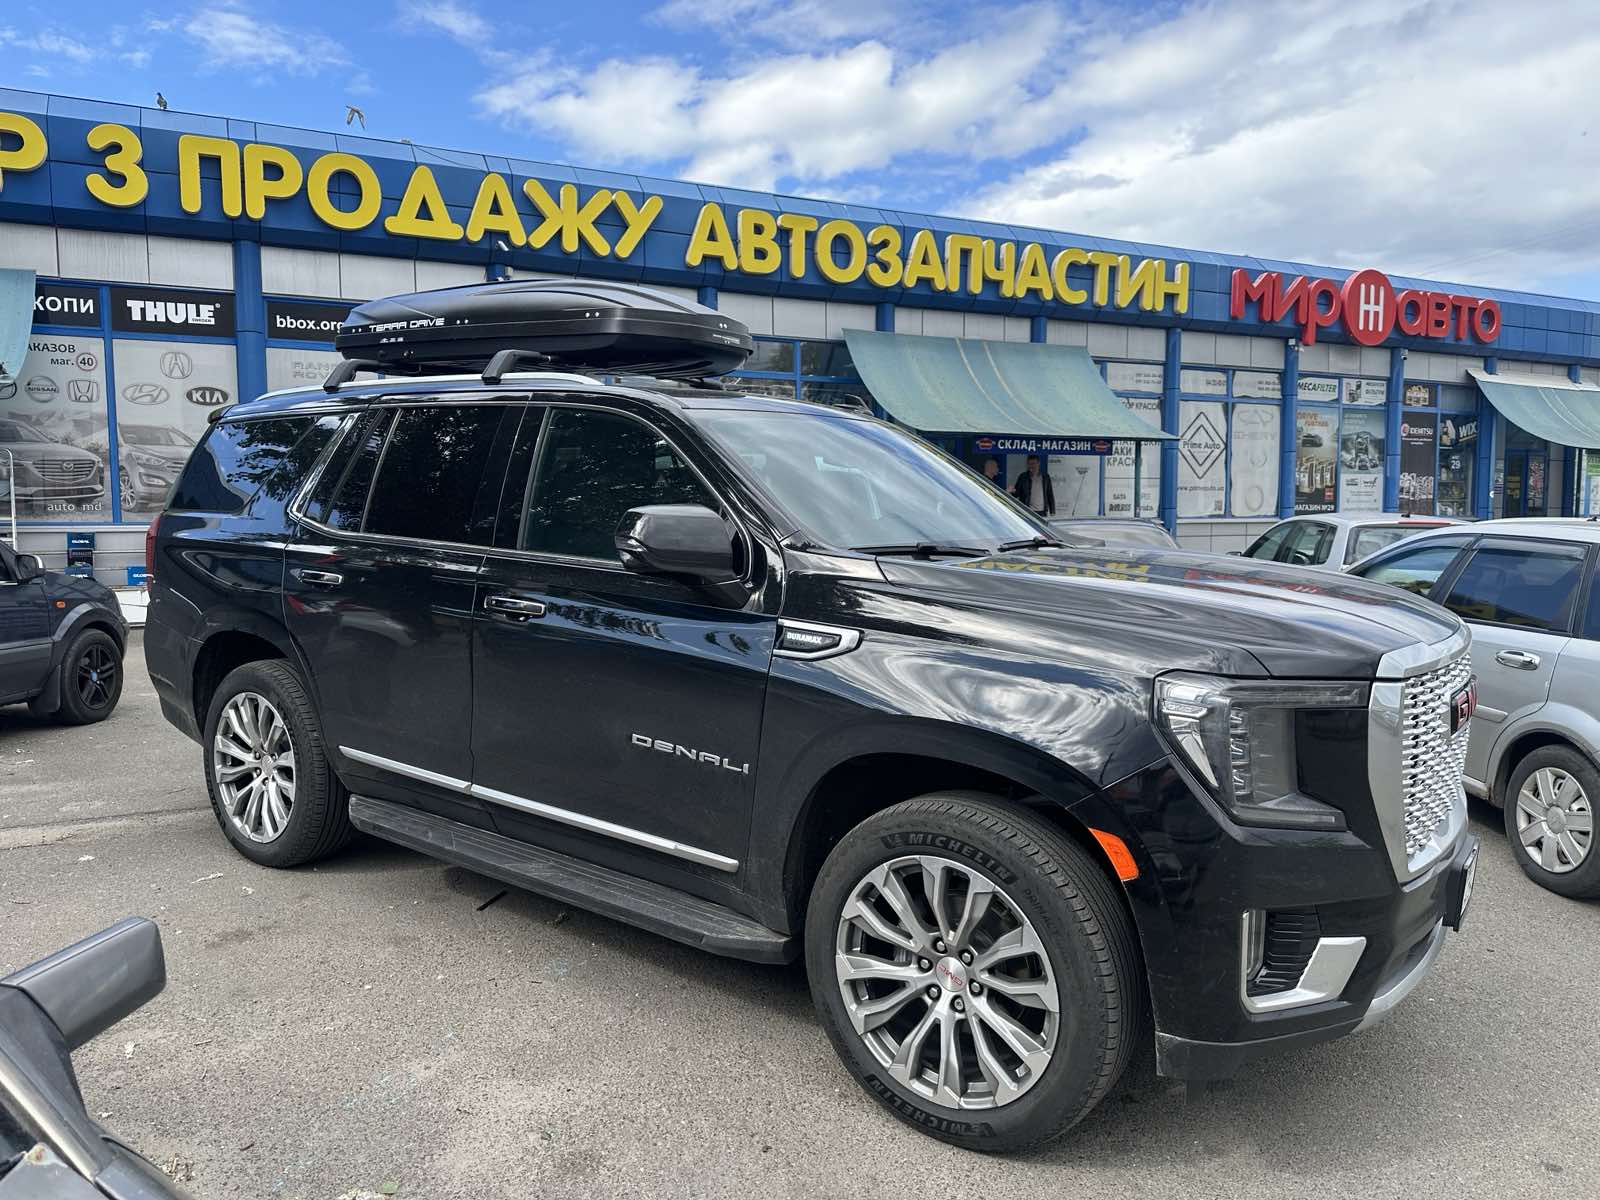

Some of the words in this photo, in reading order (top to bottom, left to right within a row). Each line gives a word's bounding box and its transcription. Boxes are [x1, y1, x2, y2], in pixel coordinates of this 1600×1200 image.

[179, 134, 664, 258] ПРОДАЖУ
[685, 202, 1189, 314] АВТОЗАПЧАСТИН
[127, 300, 215, 325] THULE
[369, 321, 407, 333] TERRA
[409, 317, 445, 328] DRIVE
[80, 357, 94, 366] 40
[192, 390, 224, 403] KIA
[997, 439, 1091, 451] СКЛАД-МАГАЗИН
[1451, 460, 1461, 469] 29
[787, 631, 822, 644] DURAMAX
[631, 733, 749, 774] DENALI
[909, 832, 1016, 885] MICHELIN
